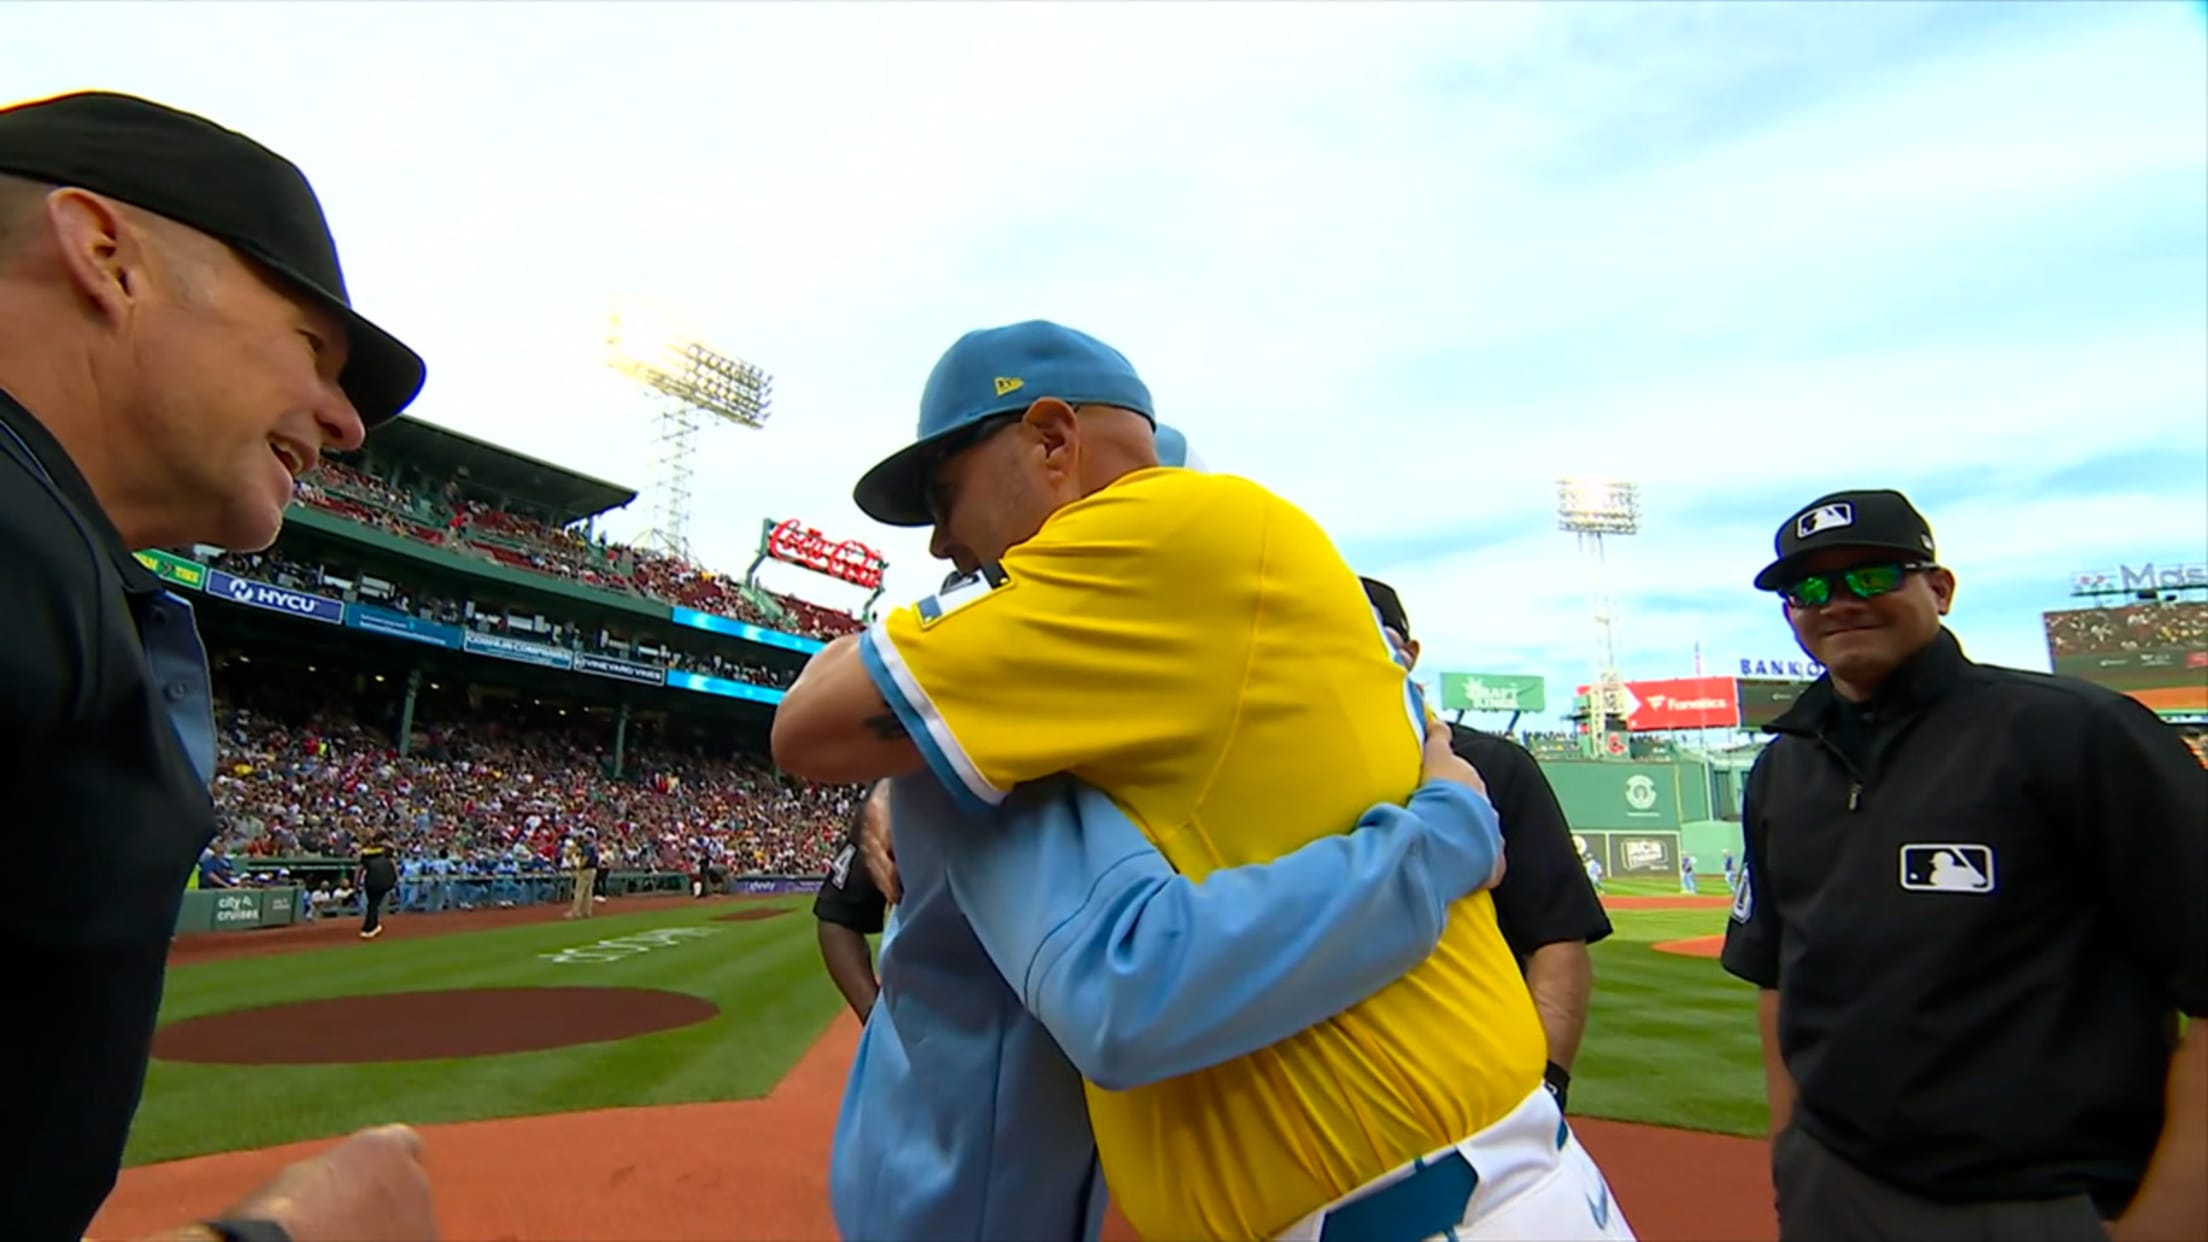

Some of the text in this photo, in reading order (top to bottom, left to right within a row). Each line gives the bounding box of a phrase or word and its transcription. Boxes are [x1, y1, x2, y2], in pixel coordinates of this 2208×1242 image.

[769, 518, 883, 590] Coca-Cola
[258, 589, 315, 612] HYCU
[1668, 698, 1727, 711] Fanatics
[218, 896, 240, 910] city
[217, 910, 259, 921] cruises
